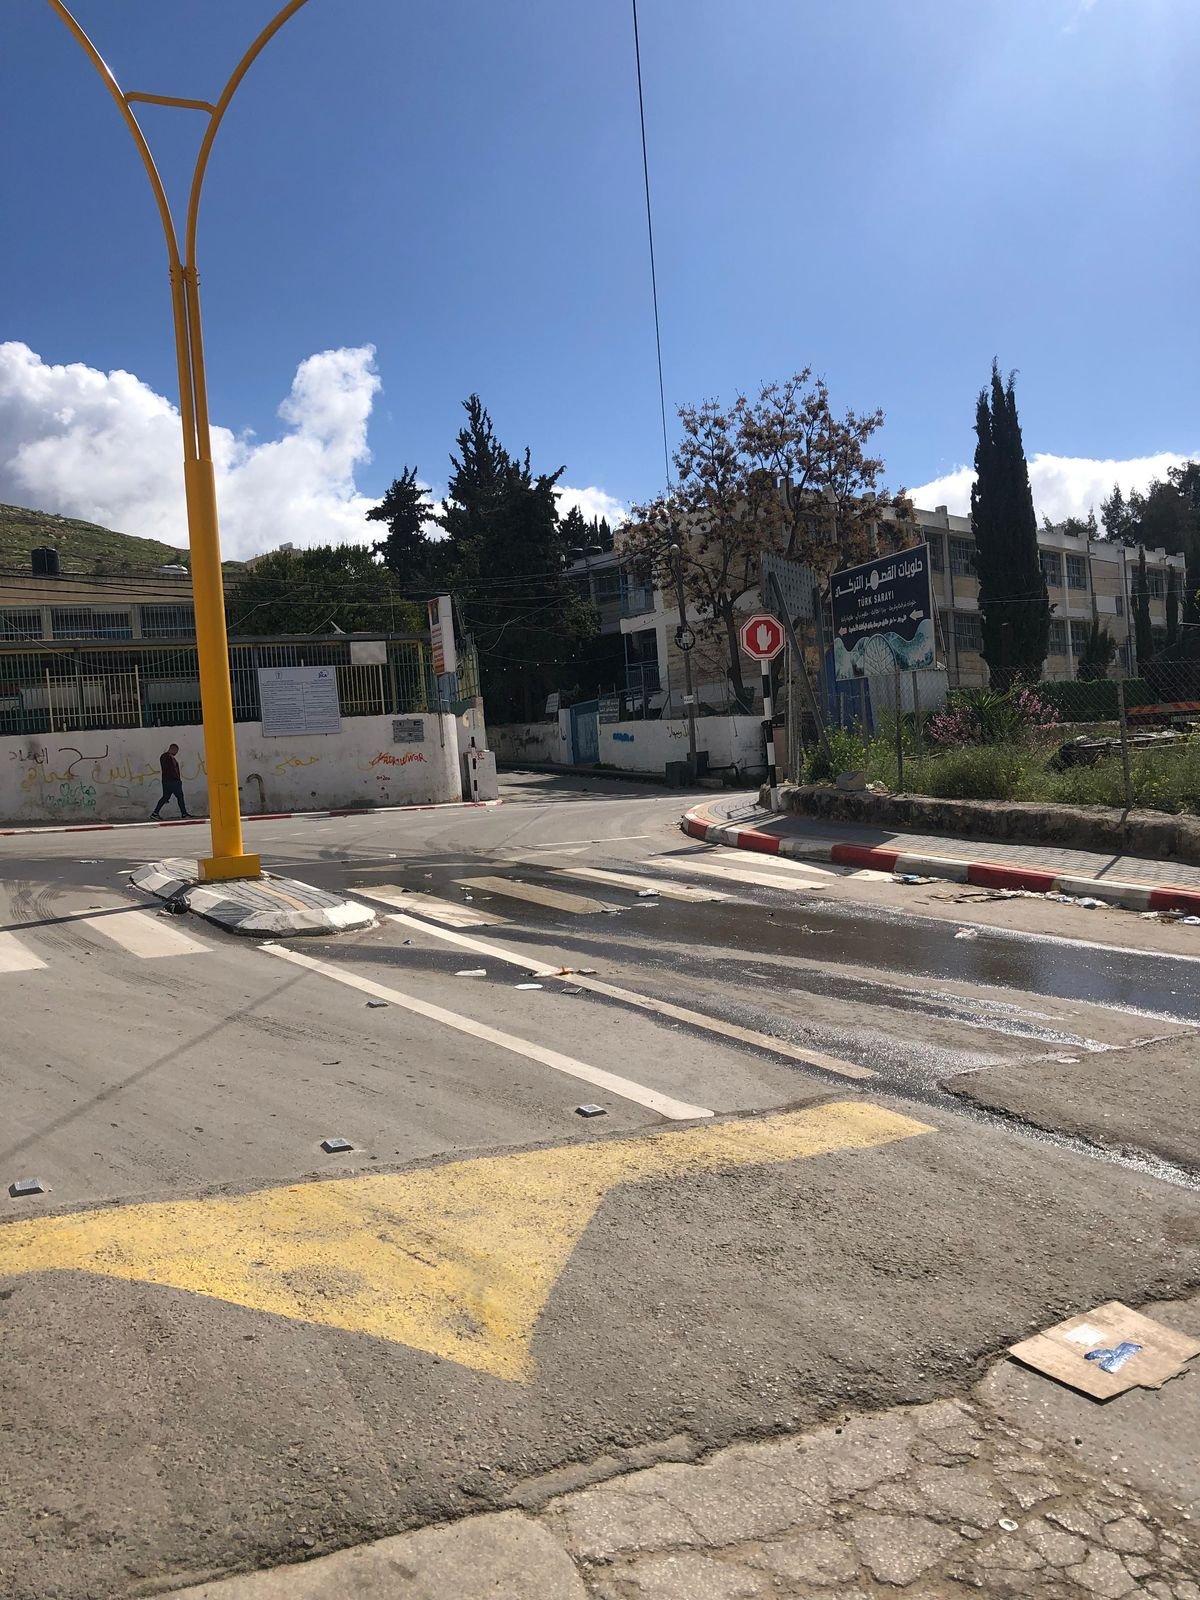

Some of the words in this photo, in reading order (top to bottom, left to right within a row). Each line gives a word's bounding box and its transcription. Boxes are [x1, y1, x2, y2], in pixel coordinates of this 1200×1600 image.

[898, 557, 923, 578] حلويات
[835, 575, 864, 598] التركي
[858, 595, 872, 608] TÜRK
[873, 590, 894, 603] SARAYI
